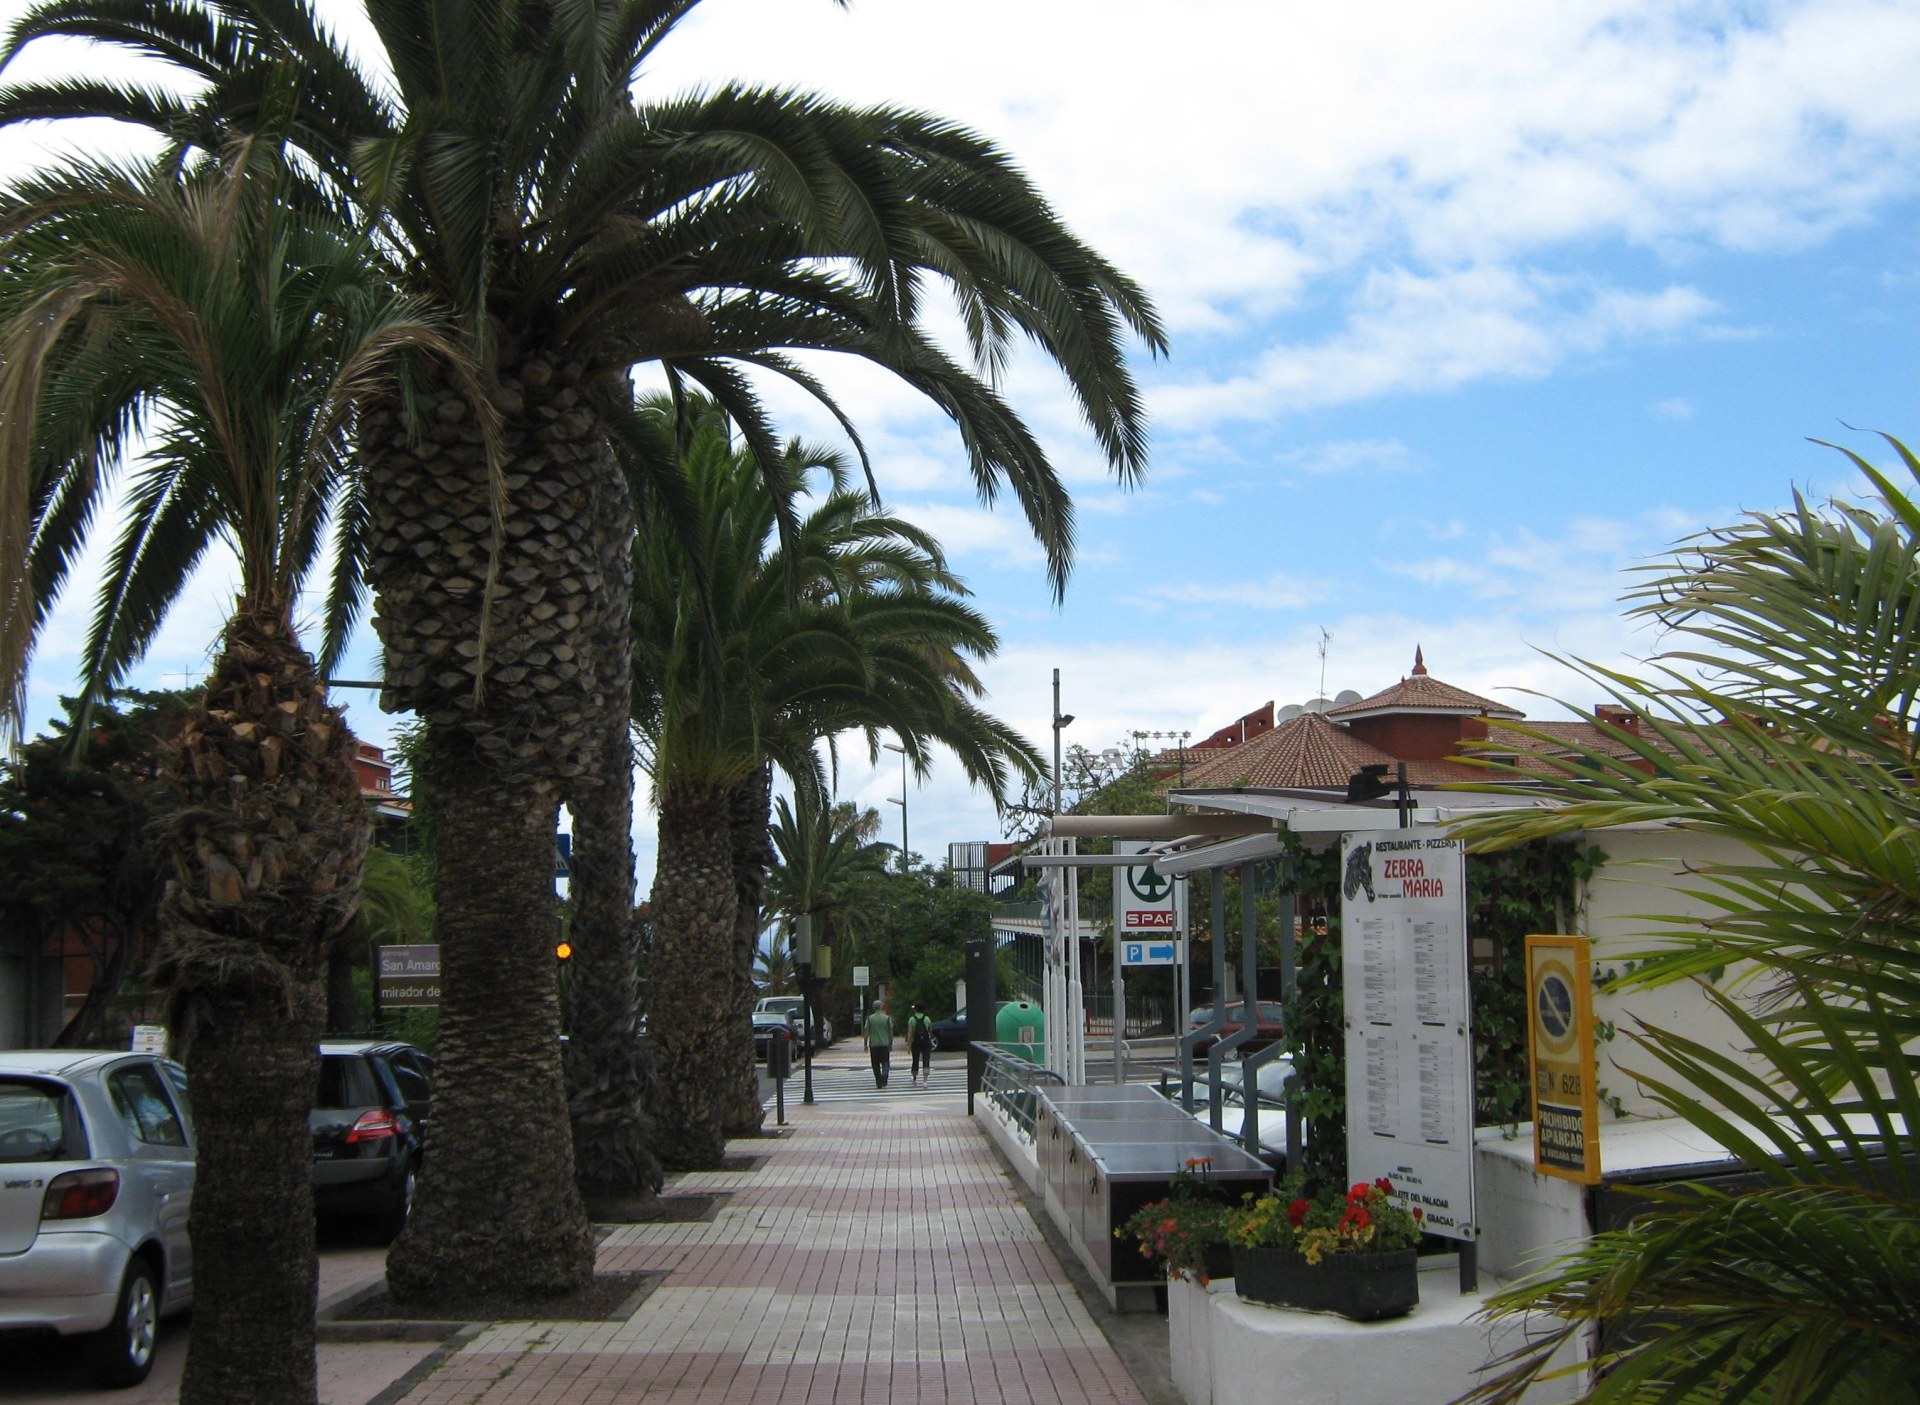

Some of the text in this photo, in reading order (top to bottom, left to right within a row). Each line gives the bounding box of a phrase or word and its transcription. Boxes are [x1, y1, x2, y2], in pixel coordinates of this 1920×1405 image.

[1376, 840, 1421, 852] RESTAURANTE
[1384, 859, 1424, 878] ZEBRA
[1403, 878, 1443, 898] MARIA
[1130, 947, 1140, 960] P
[382, 959, 404, 971] San
[381, 985, 441, 998] mirador de
[1538, 1110, 1584, 1132] PROHIBIDO
[1541, 1127, 1583, 1150] APARCAR
[1426, 1213, 1454, 1227] GRACIAS
